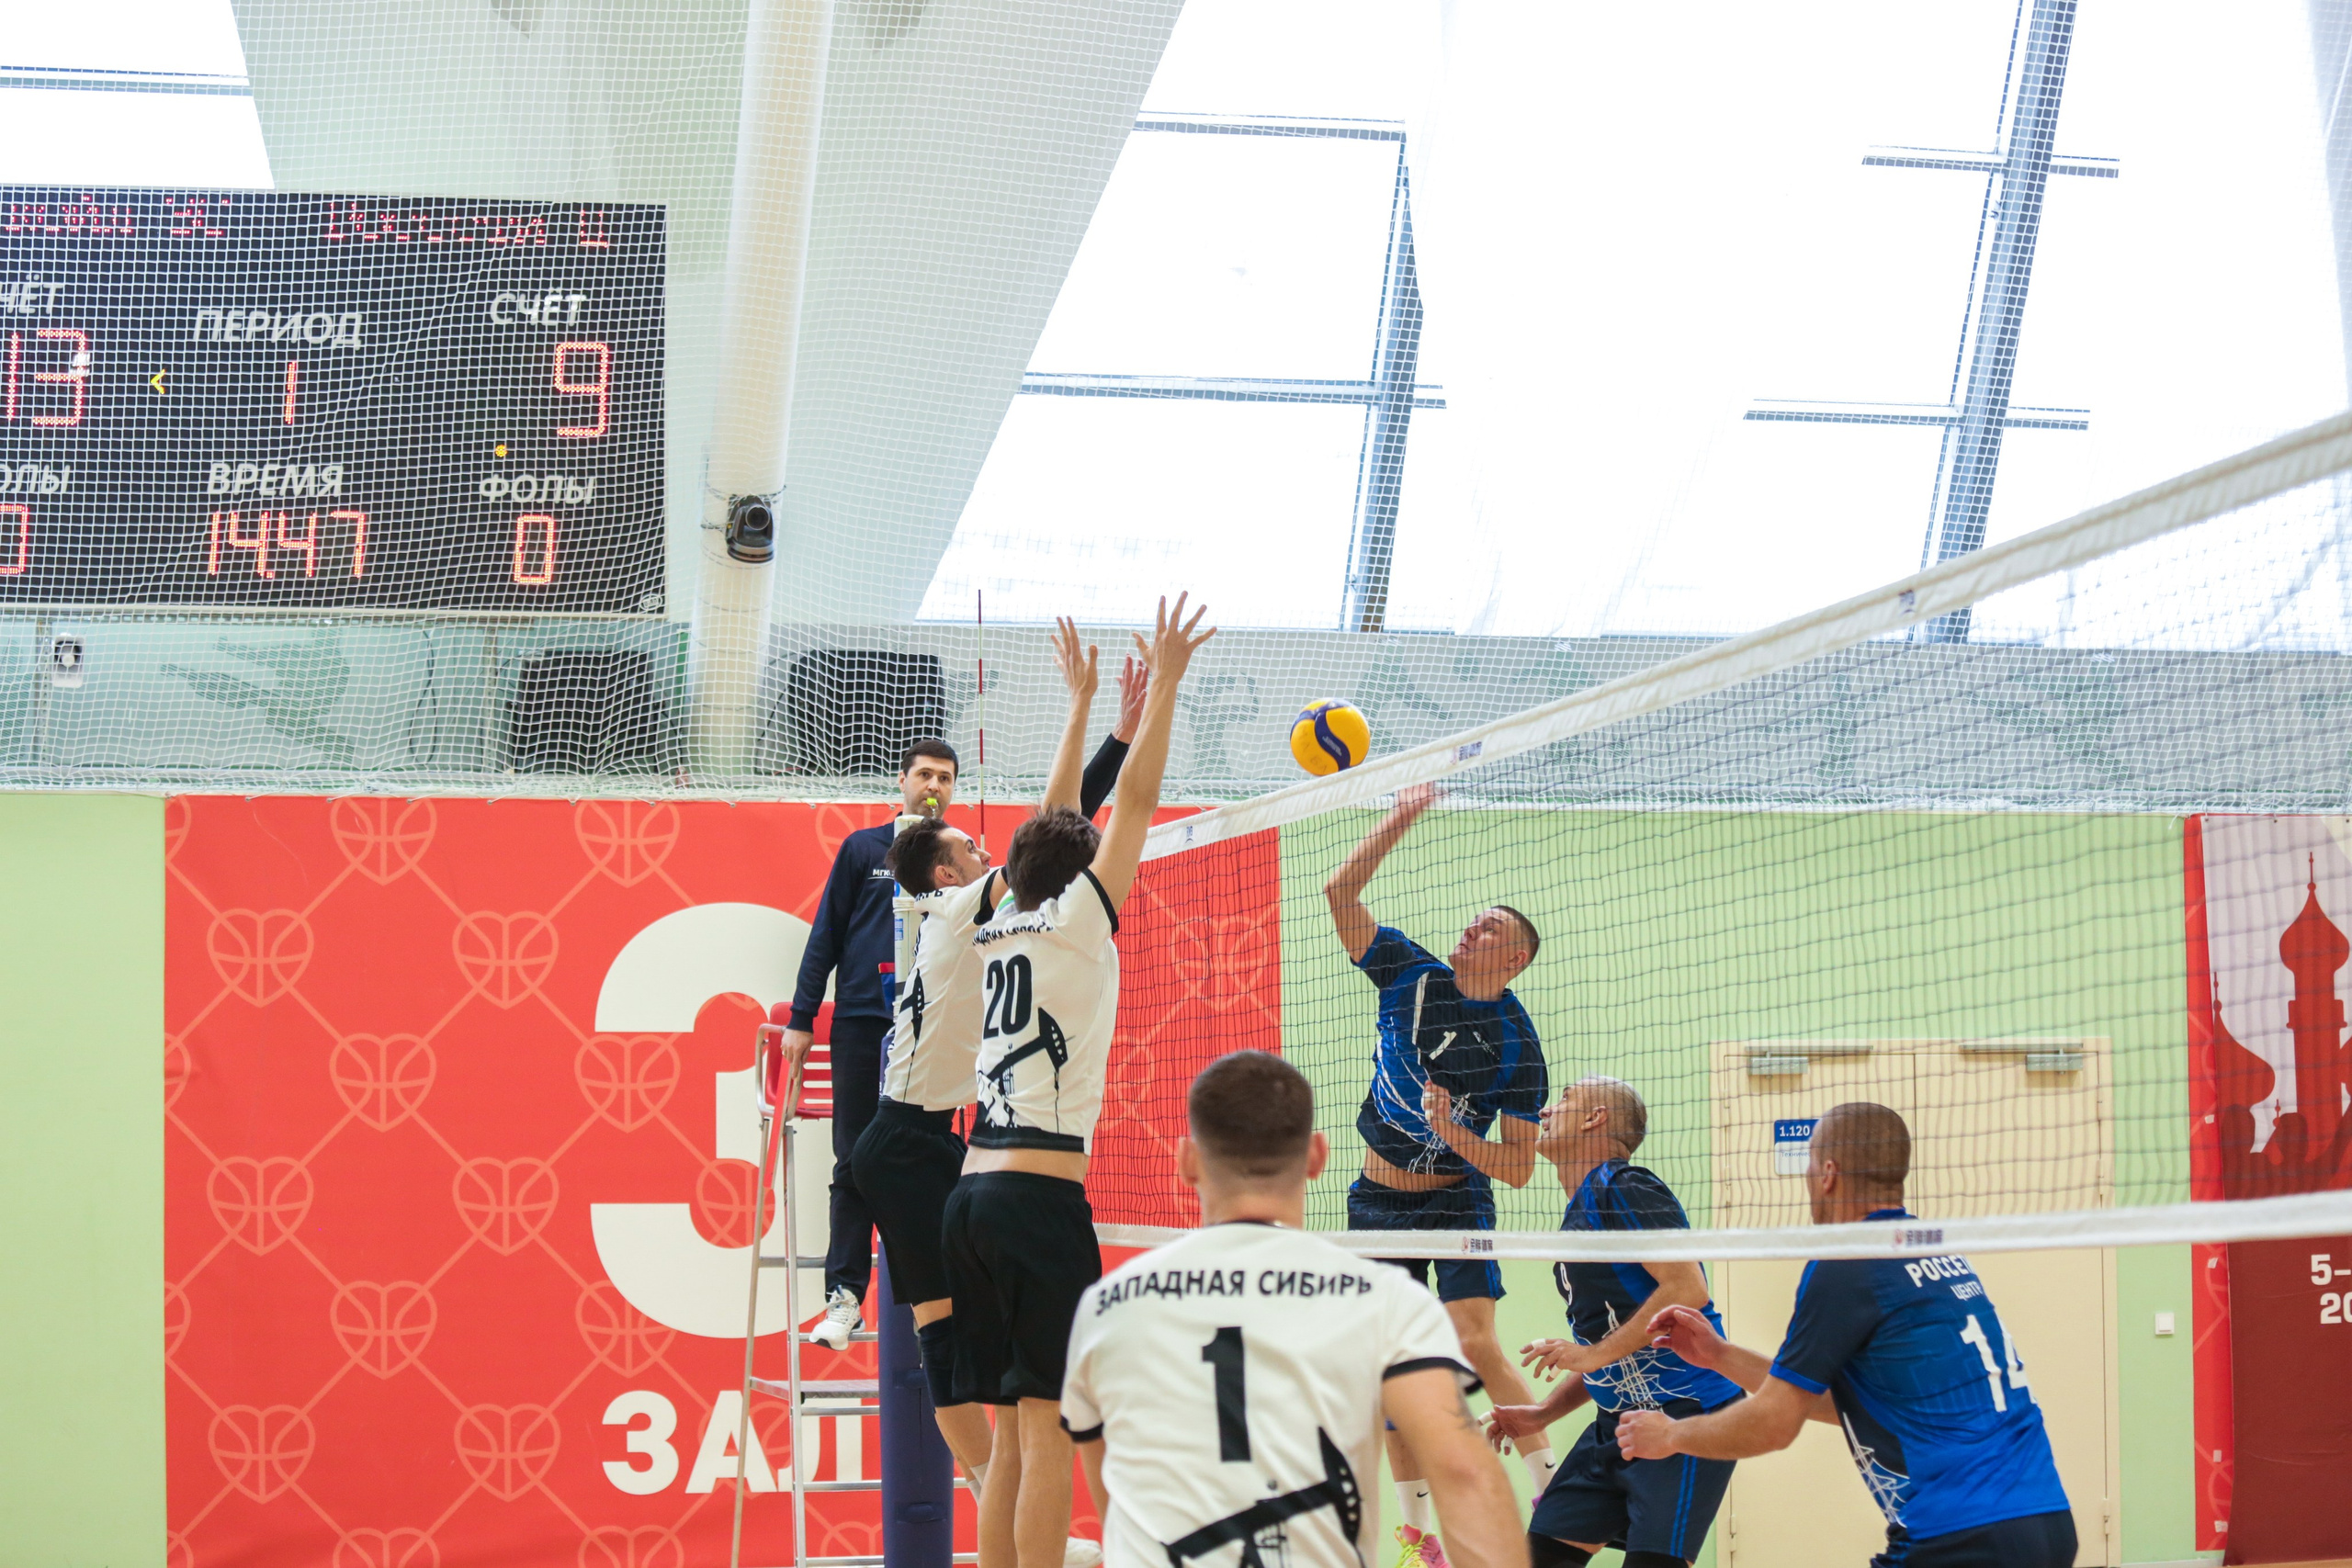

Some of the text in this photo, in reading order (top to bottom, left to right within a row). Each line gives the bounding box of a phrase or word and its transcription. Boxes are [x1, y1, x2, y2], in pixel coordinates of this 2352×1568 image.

[192, 309, 362, 350] ПЕРИОД
[490, 287, 586, 326] СЧЁТ
[7, 329, 89, 424] 13
[285, 361, 297, 424] 1
[554, 342, 607, 436] 9
[207, 463, 344, 497] ВРЕМЯ
[479, 474, 595, 504] ФОЛЫ
[514, 515, 554, 584] 0
[983, 954, 1032, 1040] 20
[590, 903, 836, 1338] 3
[1780, 1124, 1810, 1136] 1.120
[1096, 1270, 1373, 1316] ЗАПАДНАЯ СИБИРЬ
[1202, 1326, 1251, 1462] 1
[1960, 1314, 2037, 1412] 14
[602, 1391, 862, 1495] ЗАЛ
